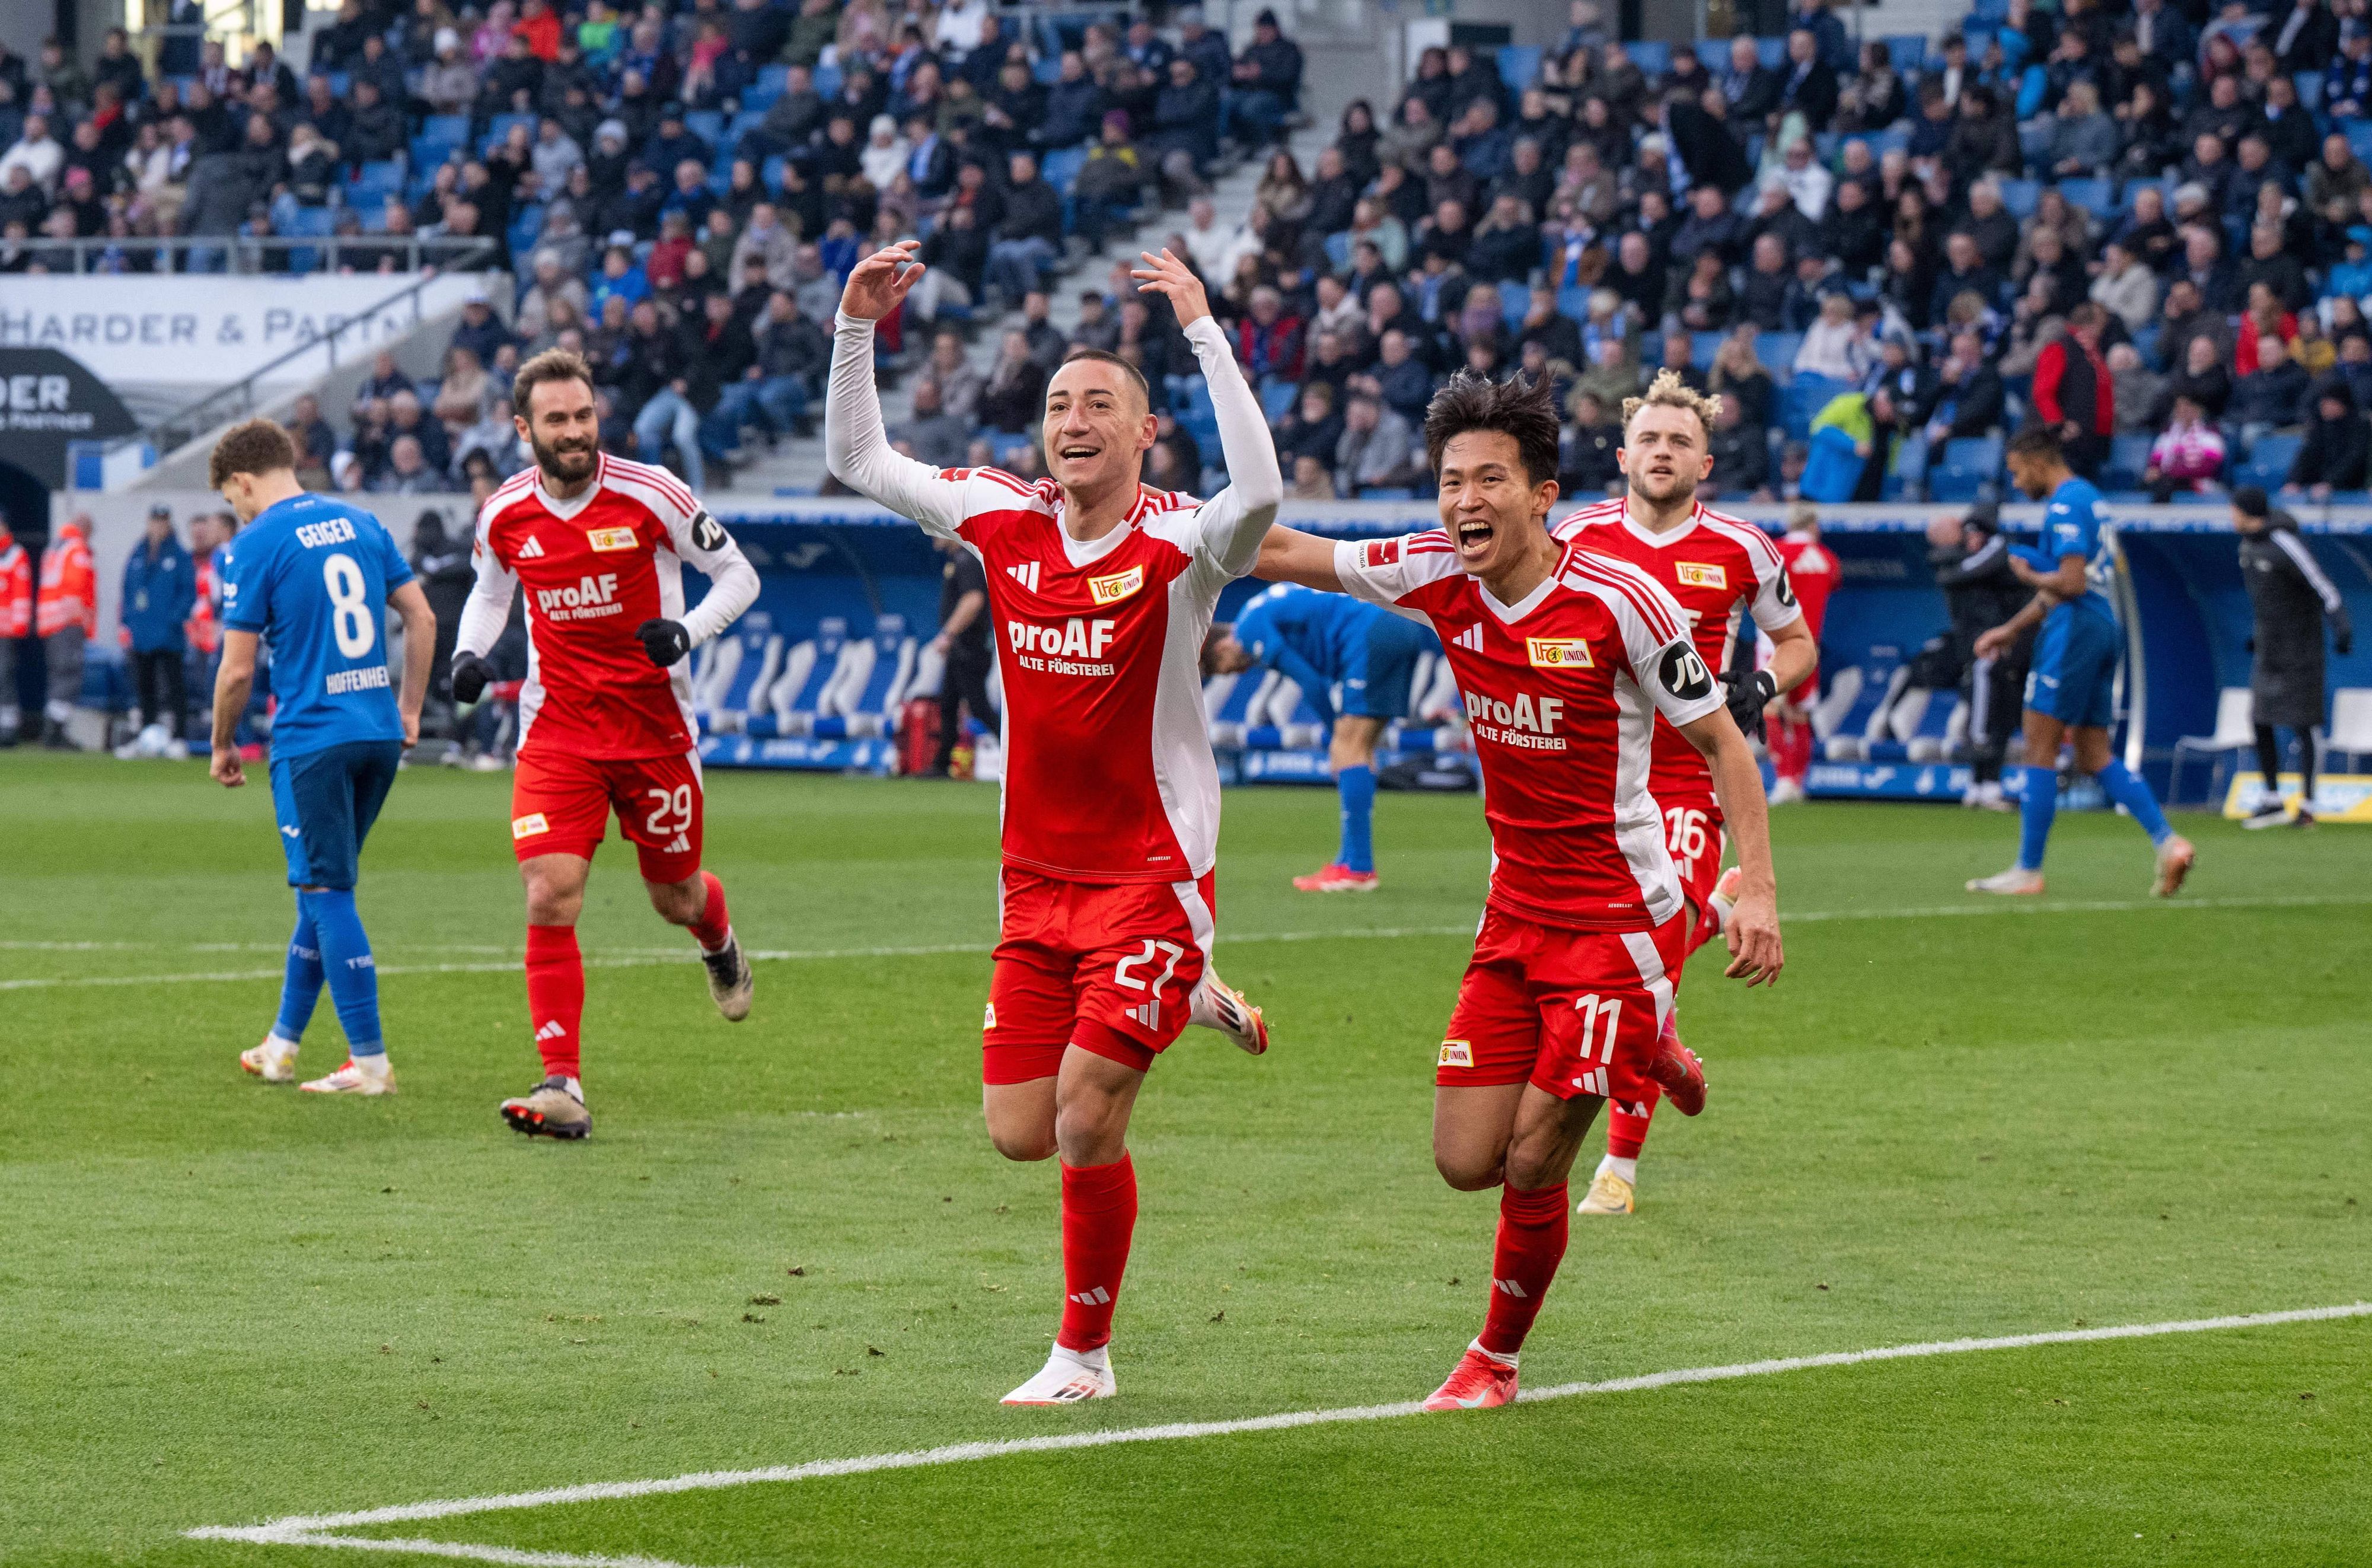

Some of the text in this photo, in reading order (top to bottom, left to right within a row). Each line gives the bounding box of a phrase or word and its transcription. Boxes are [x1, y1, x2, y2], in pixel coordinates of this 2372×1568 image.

[0, 309, 197, 346] HARDER
[216, 313, 245, 345] &
[0, 374, 69, 410] ER
[295, 518, 356, 549] GEIGER
[699, 516, 722, 550] JD
[537, 573, 618, 614] proAF
[1124, 576, 1140, 590] UNION
[1783, 572, 1793, 604] J
[323, 553, 374, 659] 8
[550, 602, 623, 622] ALTE FÖRSTEREI
[1008, 617, 1115, 659] proAF
[1563, 650, 1587, 661] UNION
[1019, 654, 1115, 676] ALTE FÖRSTEREI
[1672, 651, 1705, 693] JD
[1465, 690, 1564, 734] proAF
[1477, 723, 1567, 750] ALTE FÖRSTEREI
[647, 783, 692, 834] 29
[1665, 807, 1708, 860] 16
[1114, 939, 1184, 1000] 27
[1575, 993, 1622, 1065] 11
[1450, 1050, 1468, 1060] UNION
